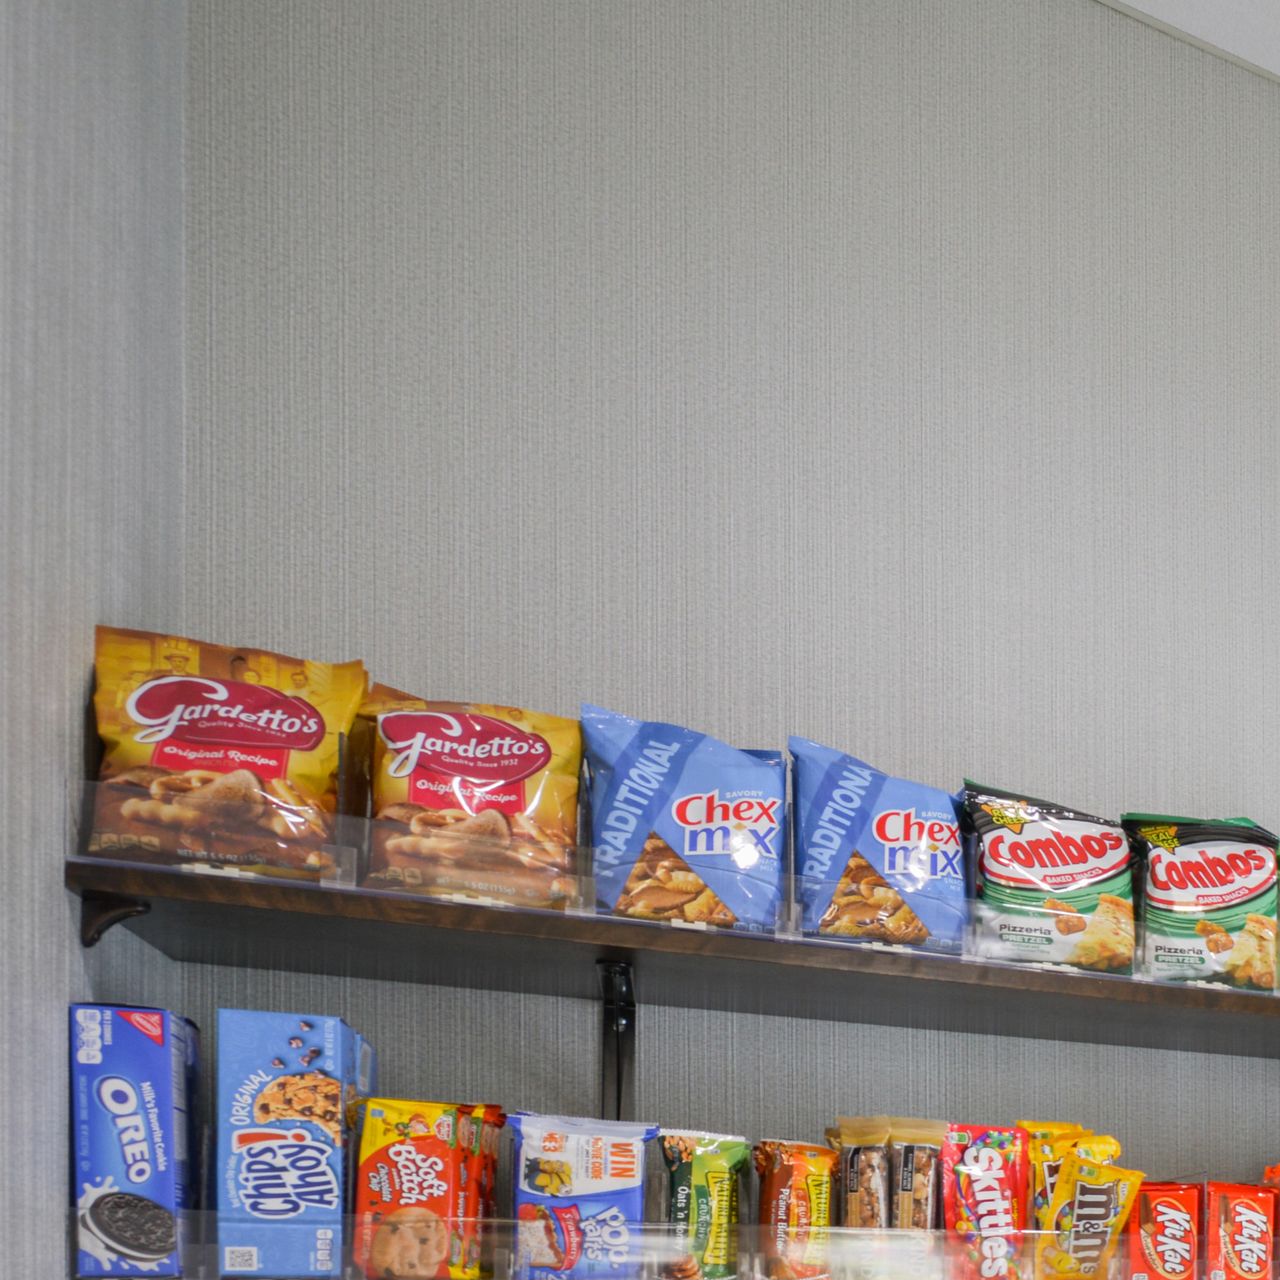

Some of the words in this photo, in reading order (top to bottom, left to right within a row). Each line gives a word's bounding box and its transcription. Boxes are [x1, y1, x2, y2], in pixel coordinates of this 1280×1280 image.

[126, 675, 319, 744] Gardetto's
[164, 745, 225, 764] Original
[228, 749, 279, 768] Recipe
[378, 711, 545, 779] Gardetto's
[675, 795, 778, 827] Chex
[875, 812, 961, 846] Chex
[989, 832, 1123, 870] Combos
[1150, 849, 1267, 892] Combos
[999, 924, 1052, 936] Pizzeria
[1002, 935, 1051, 944] PRETZEL
[1154, 944, 1203, 956] Pizzeria
[141, 1081, 155, 1107] Milk's
[229, 1069, 273, 1125] ORIGINAL
[100, 1077, 152, 1184] OREO
[147, 1107, 162, 1142] Favorite
[154, 1142, 167, 1172] Cookie
[388, 1144, 428, 1205] Batch
[590, 1161, 603, 1180] CODE
[610, 1143, 636, 1179] WIN
[240, 1146, 300, 1214] Chips
[415, 1155, 447, 1197] Soft
[676, 1186, 689, 1208] Oats
[778, 1188, 789, 1220] Peanut
[963, 1147, 1014, 1279] Skittles
